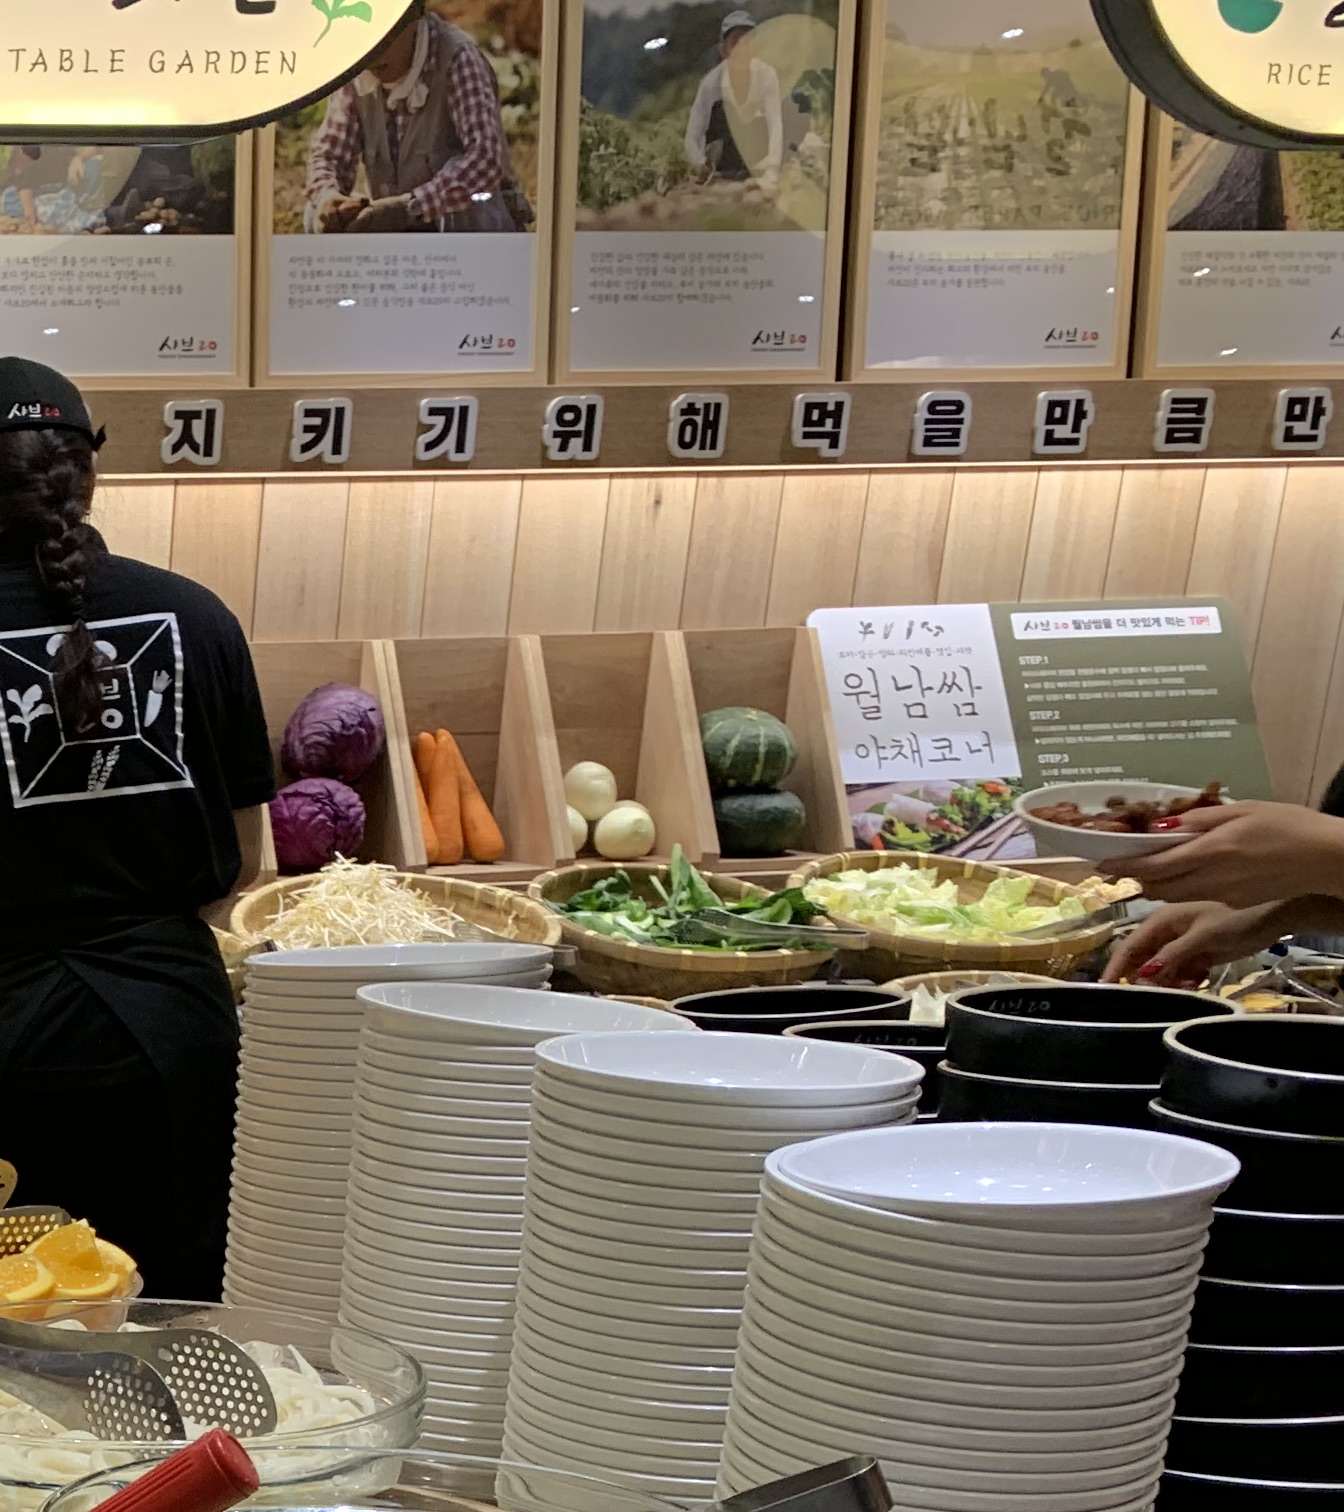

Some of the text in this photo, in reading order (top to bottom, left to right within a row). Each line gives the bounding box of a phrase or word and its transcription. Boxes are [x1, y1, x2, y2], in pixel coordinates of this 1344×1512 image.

[148, 48, 299, 76] GARDEN
[1266, 62, 1333, 86] RICE
[842, 664, 983, 721] 월남쌈
